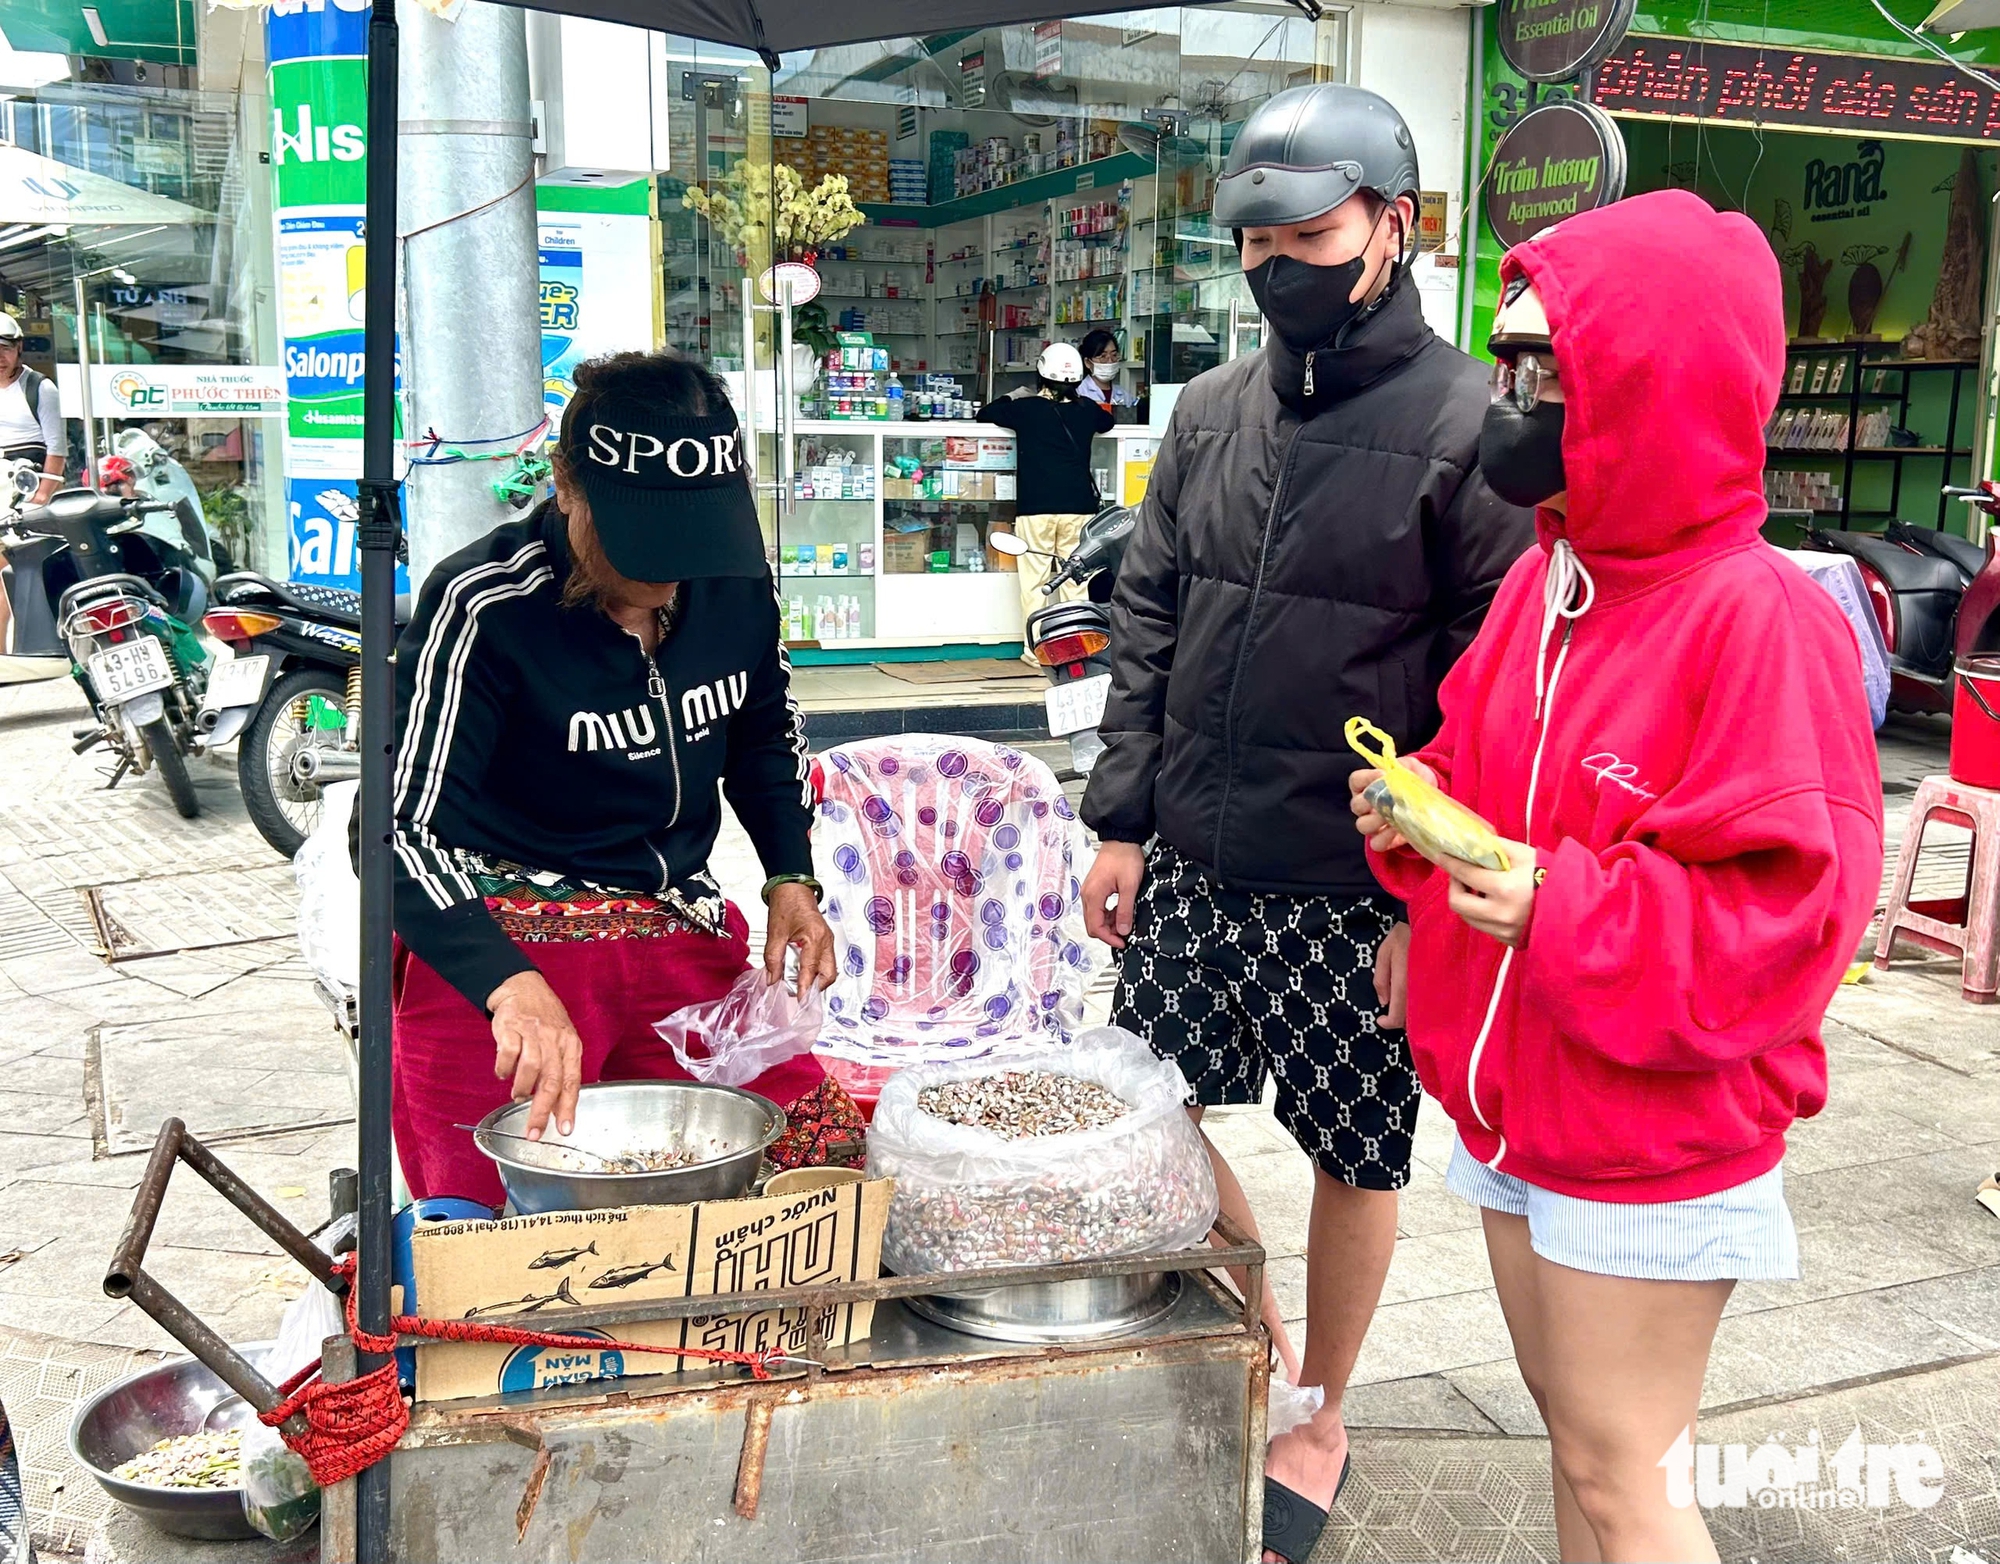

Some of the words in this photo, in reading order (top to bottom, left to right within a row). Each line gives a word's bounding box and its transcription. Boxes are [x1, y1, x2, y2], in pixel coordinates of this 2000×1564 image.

[1515, 10, 1576, 42] Essential
[1577, 5, 1599, 30] Oil
[1494, 157, 1539, 195] Trầm
[1541, 156, 1600, 194] hương
[1507, 191, 1578, 225] Agarwood
[544, 236, 575, 245] Children
[172, 386, 229, 400] PHƯỚC
[109, 664, 159, 693] 5496
[568, 704, 656, 752] MIU
[627, 747, 661, 761] Silence
[685, 734, 693, 742] is
[694, 727, 710, 742] gold
[781, 1187, 837, 1222] Nước
[500, 1219, 519, 1231] (18
[521, 1219, 527, 1229] L
[526, 1215, 553, 1228] 14,4
[585, 1213, 606, 1225] tích
[607, 1212, 628, 1225] Thể
[443, 1224, 464, 1236] 800
[466, 1224, 473, 1232] x
[475, 1221, 498, 1234] chai
[715, 1215, 775, 1248] chấm
[545, 1353, 591, 1371] MẶN
